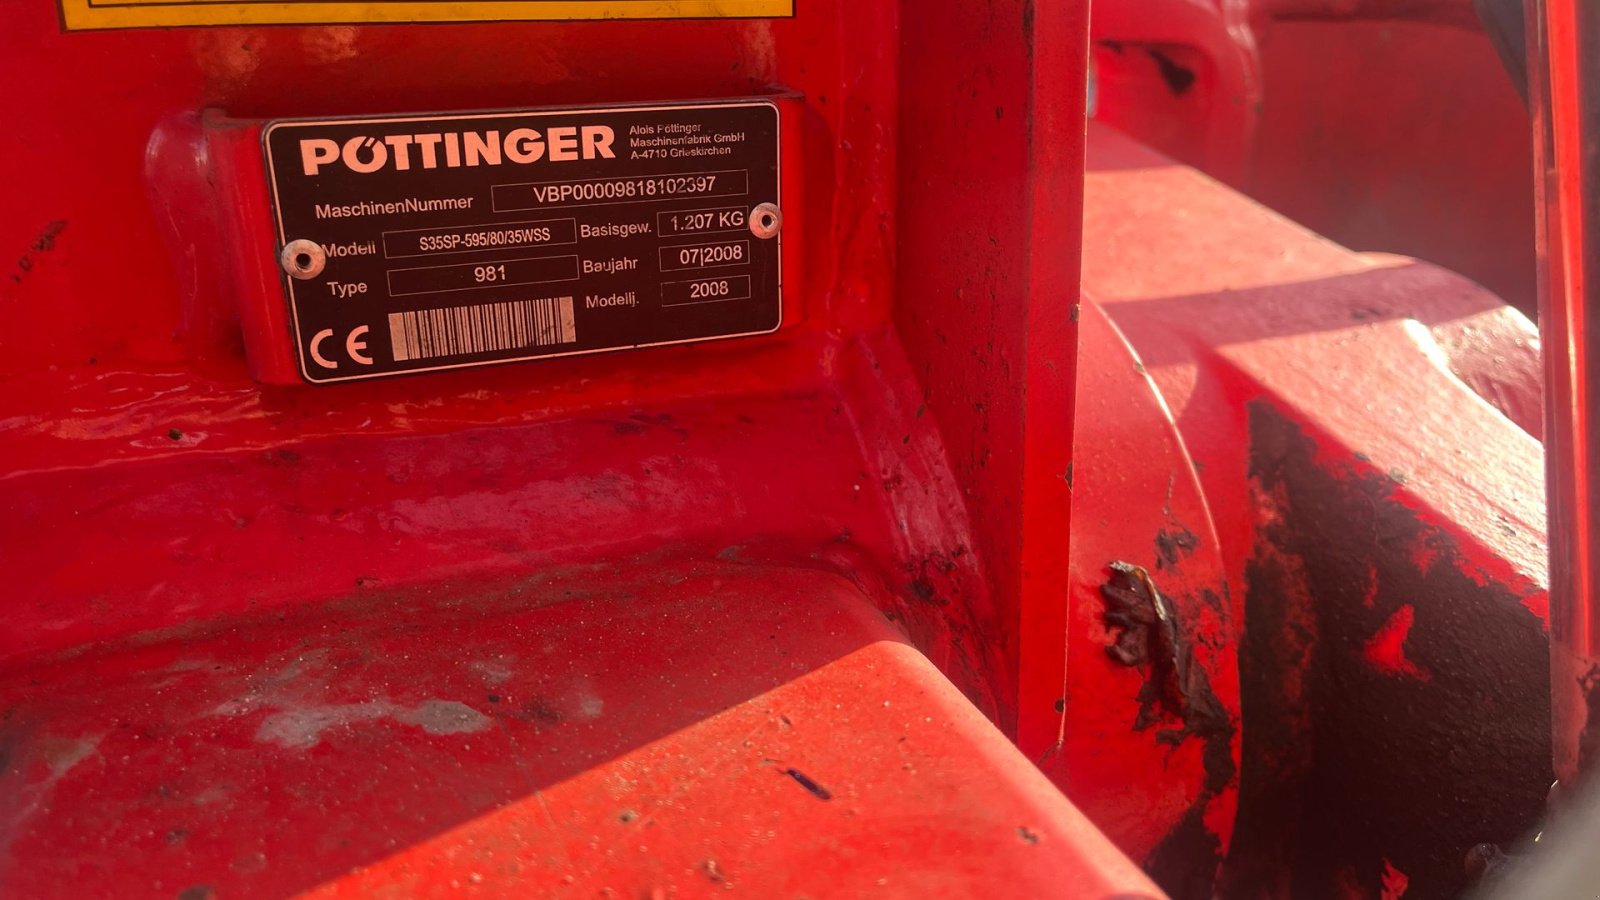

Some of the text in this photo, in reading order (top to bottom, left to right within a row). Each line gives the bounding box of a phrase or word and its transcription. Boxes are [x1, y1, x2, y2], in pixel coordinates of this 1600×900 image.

[629, 124, 655, 136] Alois
[630, 132, 745, 148] Maschinenfabrik GmbH
[300, 125, 616, 176] PÖTTINGER
[631, 146, 732, 160] A-4710 Grieskirchen
[315, 176, 716, 219] MaschinenNummer VBP00009818102397
[580, 211, 744, 239] Basisgew. 1.207 KG
[321, 227, 551, 258] Modell S35SP-595/80/35WSS
[583, 257, 638, 274] Baujahr
[327, 265, 506, 298] Type 981
[586, 281, 729, 309] Modellj. 2008
